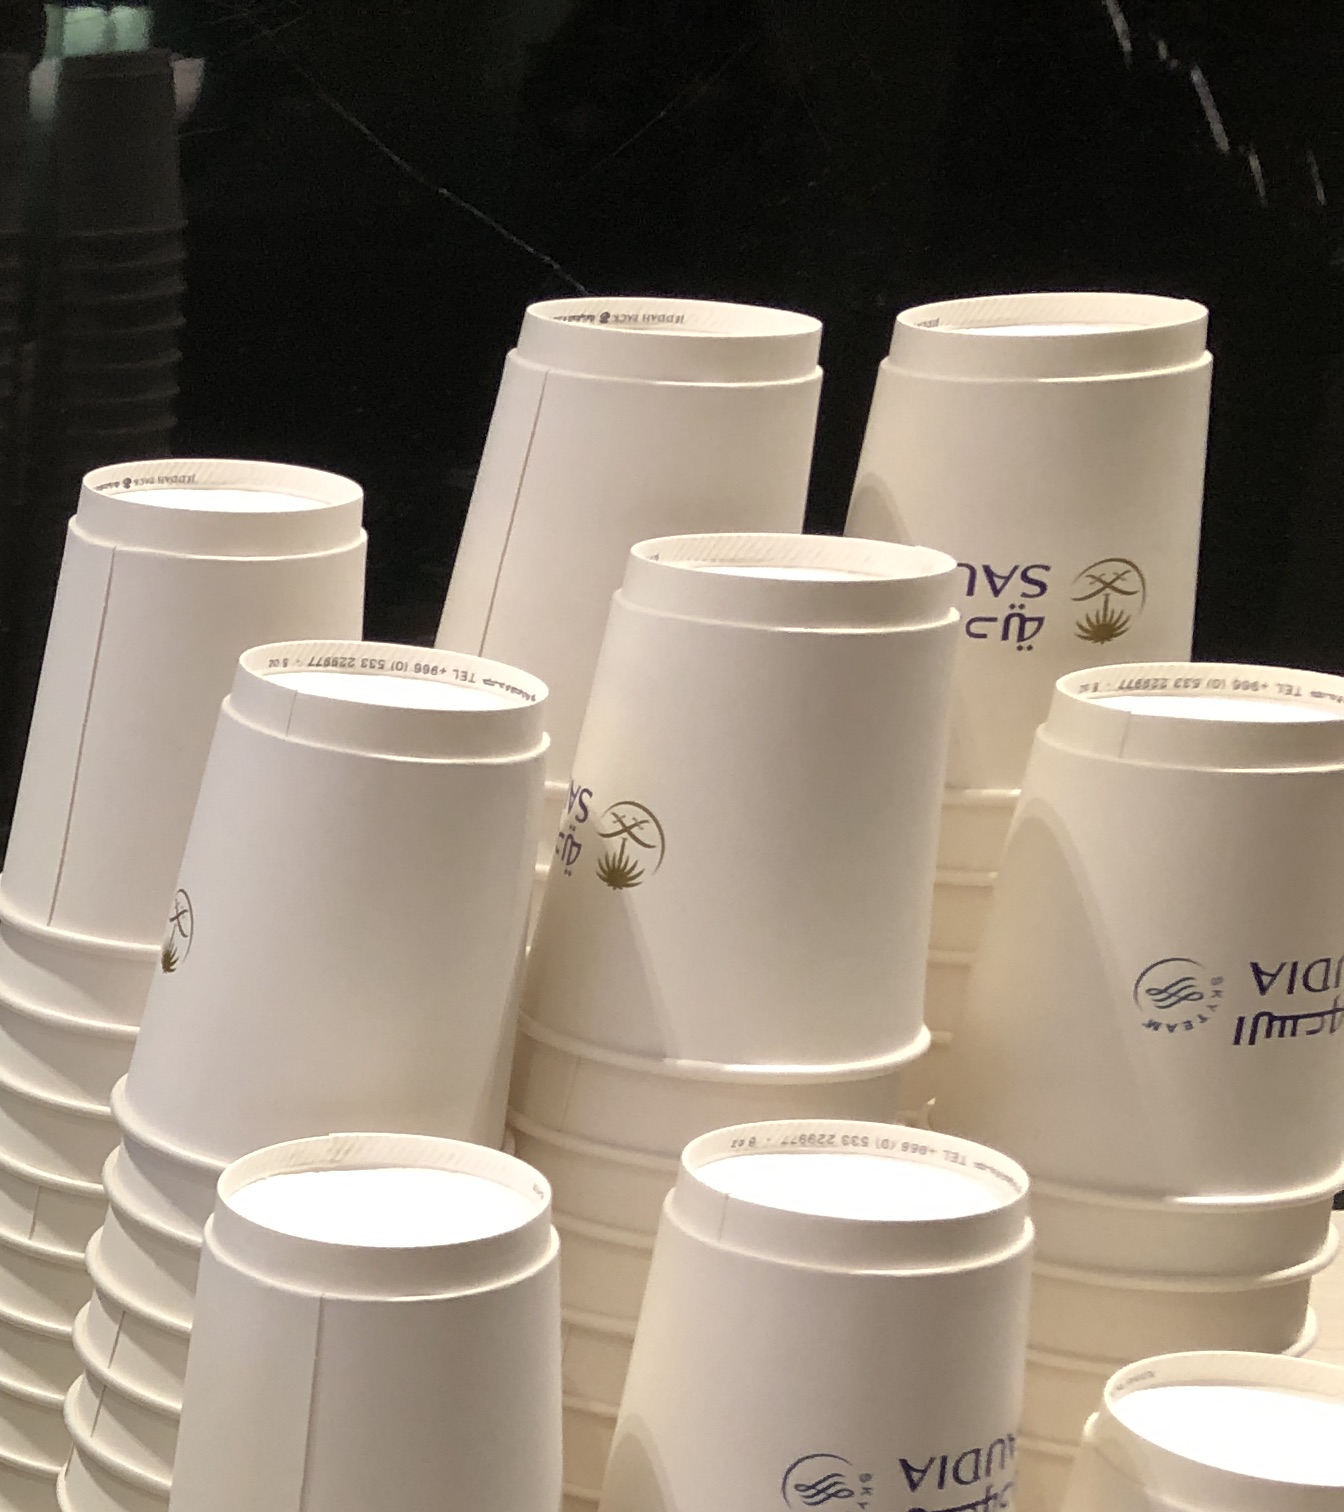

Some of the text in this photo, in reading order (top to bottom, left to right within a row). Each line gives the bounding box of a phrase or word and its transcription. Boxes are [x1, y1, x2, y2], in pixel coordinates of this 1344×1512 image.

[308, 655, 356, 669] 229977
[360, 657, 386, 671] 533
[414, 662, 448, 677] +966
[452, 668, 477, 684] TEL
[1275, 683, 1302, 699] TEL
[840, 1134, 870, 1149] 533
[941, 1148, 968, 1167] TEL
